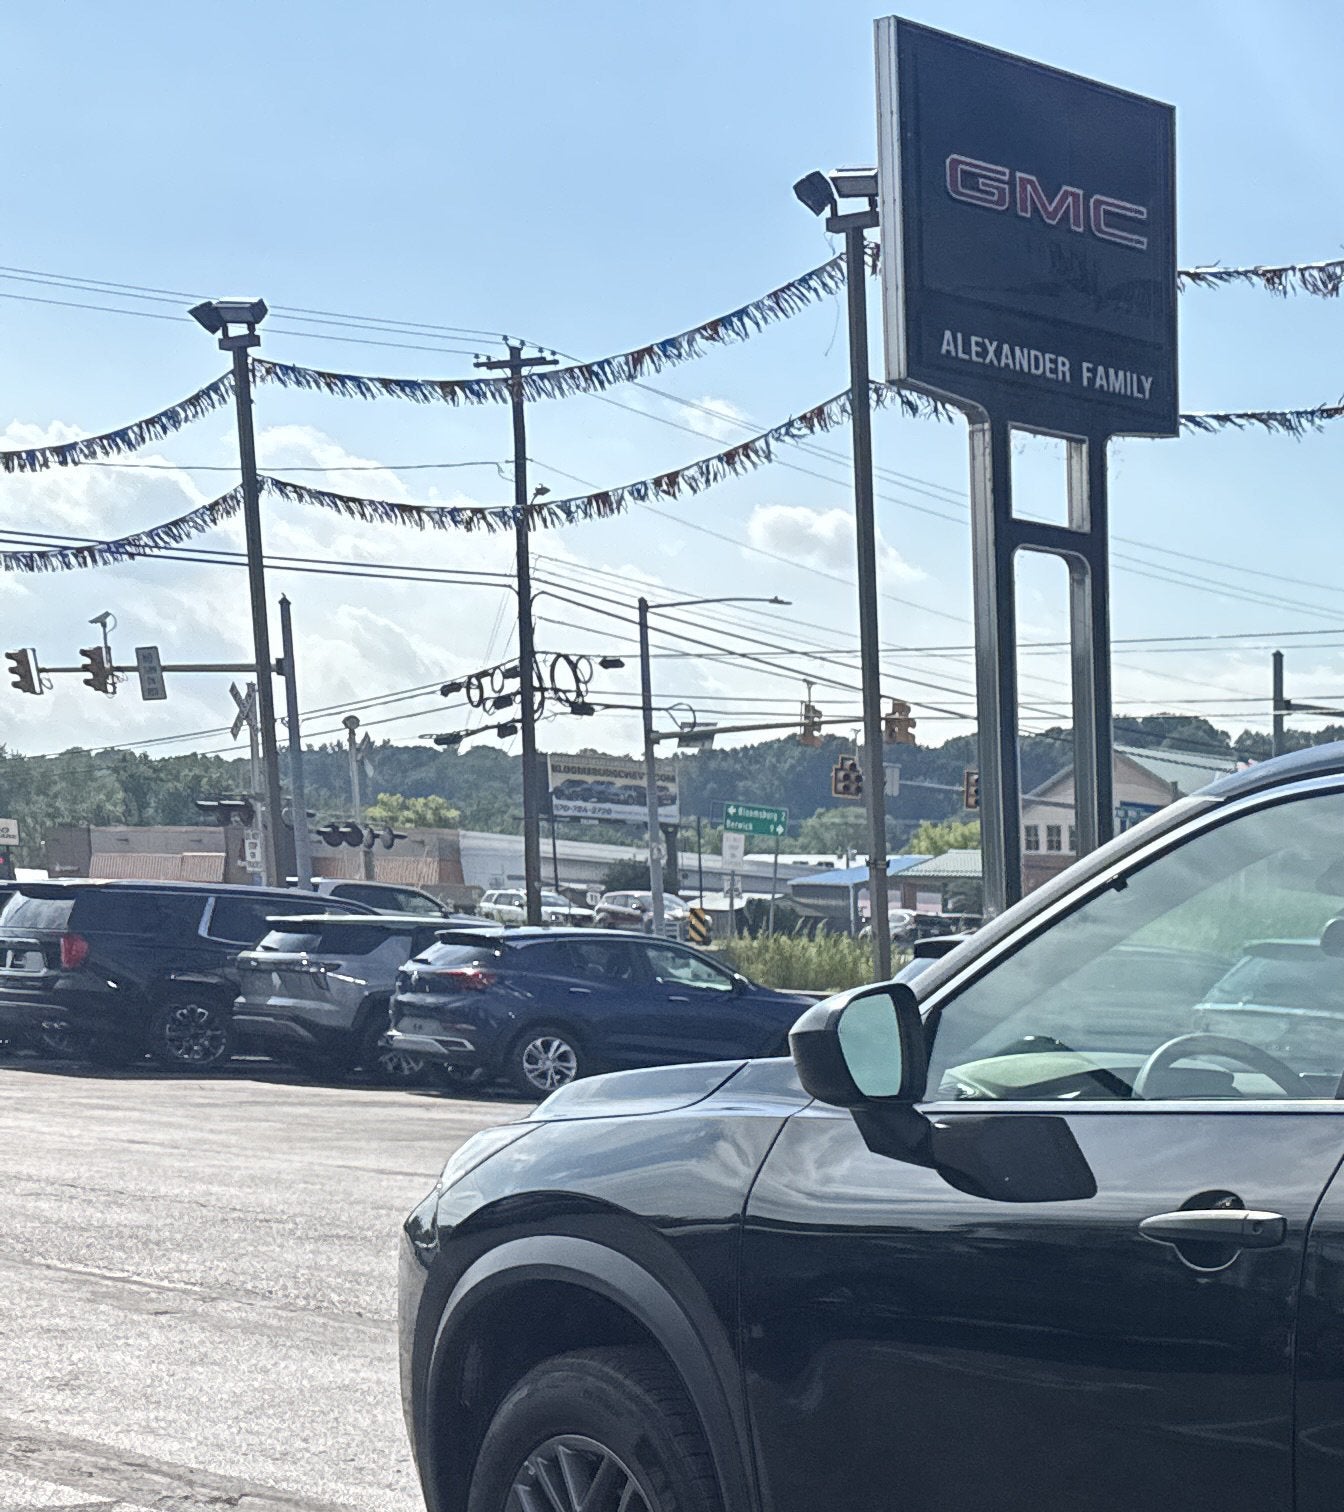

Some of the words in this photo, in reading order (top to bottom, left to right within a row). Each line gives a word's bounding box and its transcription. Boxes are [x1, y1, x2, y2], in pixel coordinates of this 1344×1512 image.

[945, 153, 1148, 251] GMC
[940, 329, 1071, 383] ALEXANDER
[1081, 361, 1153, 400] FAMILY
